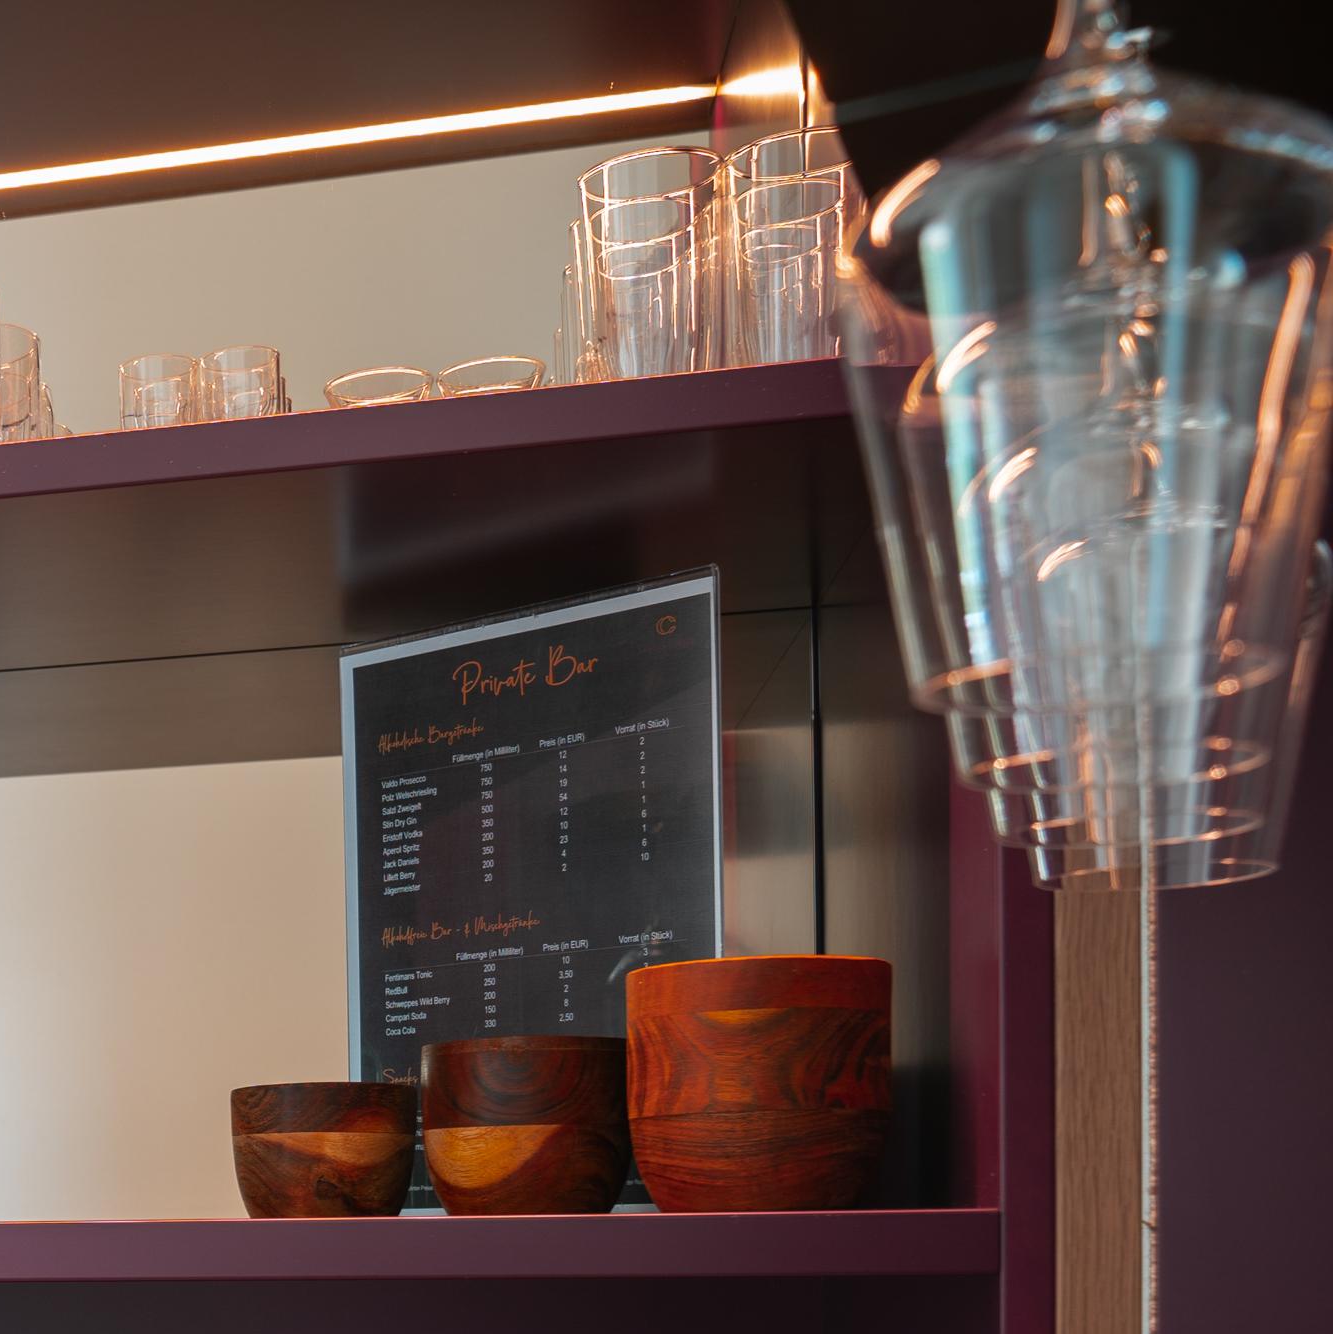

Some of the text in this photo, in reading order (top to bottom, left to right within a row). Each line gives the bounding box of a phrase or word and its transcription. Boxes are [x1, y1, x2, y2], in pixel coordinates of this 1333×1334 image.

[452, 644, 598, 705] Private Bar
[614, 717, 670, 735] Vorrat (in Stück)
[539, 732, 585, 748] Preis (in EUR)
[639, 736, 645, 745] 2
[559, 750, 567, 759] 12
[639, 751, 645, 760] 2
[480, 763, 492, 772] 750
[559, 764, 567, 773] 14
[640, 766, 646, 774] 2
[399, 775, 427, 786] Prosecco
[480, 777, 492, 786] 750
[559, 778, 568, 787] 19
[481, 790, 493, 800] 750
[559, 793, 568, 802] 54
[641, 795, 646, 803] 1
[559, 807, 568, 816] 12
[641, 809, 647, 818] 6
[394, 818, 405, 828] Dry
[560, 821, 568, 829] 10
[642, 824, 646, 832] 1
[404, 830, 423, 839] Vodka
[559, 835, 569, 844] 23
[561, 849, 566, 857] 4
[640, 852, 649, 861] 10
[383, 860, 397, 869] Jack
[561, 863, 567, 872] 2
[399, 871, 416, 881] Berry
[484, 873, 493, 882] 20
[618, 930, 673, 944] Vorrat (in Stück)
[542, 939, 589, 952] Preis (in EUR)
[643, 947, 648, 956] 3
[562, 956, 570, 964] 10
[483, 963, 496, 973] 200
[416, 970, 433, 979] Tonic
[563, 984, 569, 992] 2
[484, 991, 496, 1000] 200
[419, 997, 433, 1006] Wild
[433, 996, 451, 1006] Berry
[411, 1011, 427, 1021] Soda
[385, 1026, 416, 1036] Coca Cola
